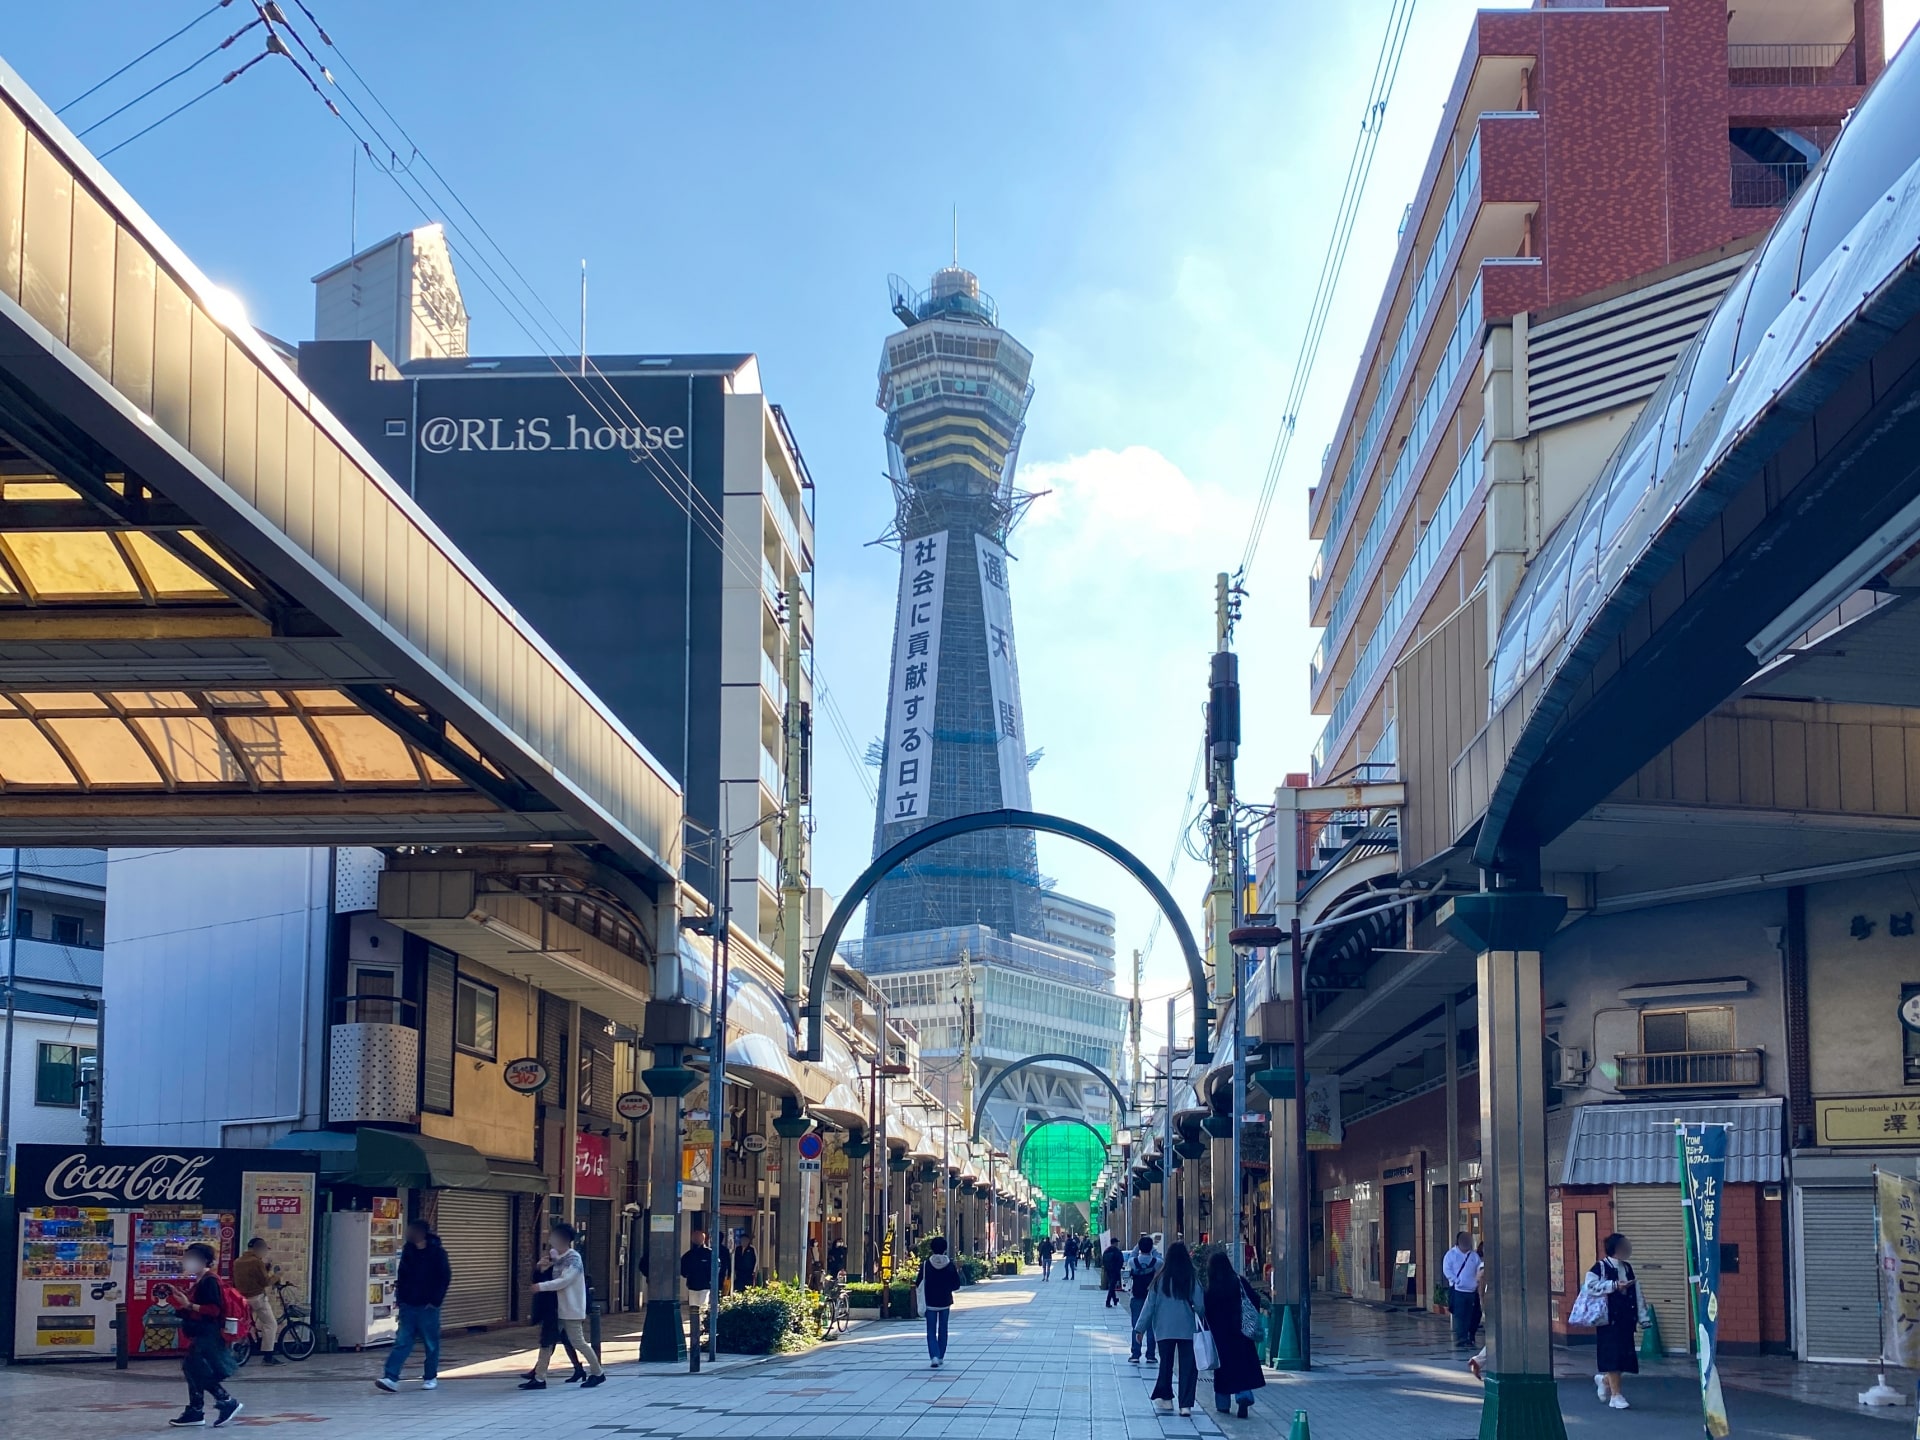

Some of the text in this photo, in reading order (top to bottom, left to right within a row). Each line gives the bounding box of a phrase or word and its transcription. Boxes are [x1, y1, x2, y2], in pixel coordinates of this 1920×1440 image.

[420, 414, 685, 454] @RLiS_house
[894, 540, 937, 819] 社会に貢献する日立
[1845, 1104, 1890, 1113] hand-made
[44, 1153, 214, 1201] Coca-Cola
[1703, 1176, 1717, 1241] 北海道
